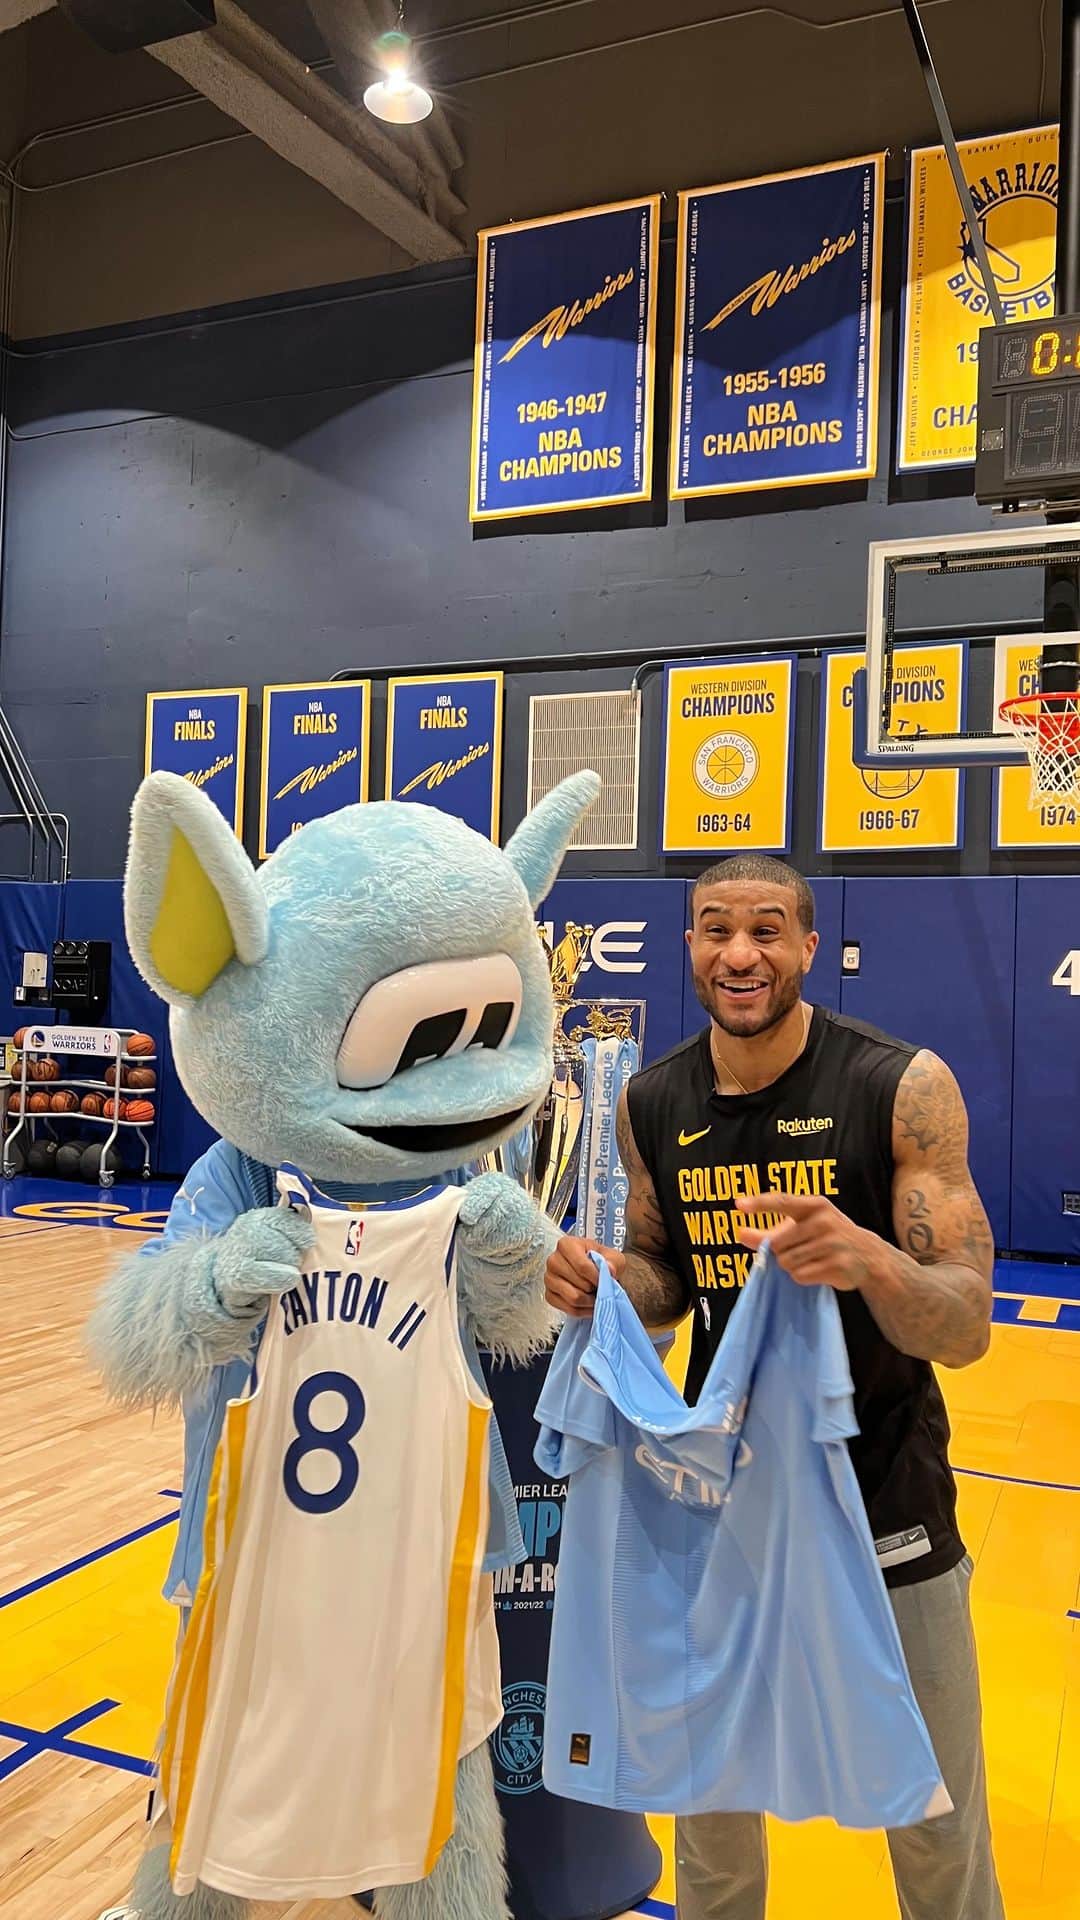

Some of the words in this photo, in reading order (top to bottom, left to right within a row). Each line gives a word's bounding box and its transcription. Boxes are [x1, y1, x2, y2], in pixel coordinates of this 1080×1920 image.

[699, 229, 856, 333] Warriors
[498, 266, 634, 364] Warriors
[723, 362, 826, 396] 1955-1956
[516, 391, 607, 423] 1946-1947
[747, 400, 797, 427] NBA
[537, 427, 583, 453] NBA
[703, 420, 842, 457] CHAMPIONS
[499, 445, 622, 482] CHAMPIONS
[896, 665, 936, 680] DIVISION
[690, 681, 729, 695] WESTERN
[730, 679, 767, 694] DIVISION
[188, 708, 202, 720] NBA
[308, 701, 323, 713] NBA
[436, 695, 452, 707] NBA
[681, 691, 775, 719] CHAMPIONS
[174, 719, 216, 741] FINALS
[293, 712, 337, 735] FINALS
[420, 706, 468, 730] FINALS
[698, 747, 711, 766] SAN
[711, 736, 754, 764] FRANCISCO
[878, 743, 915, 753] SPALDING
[273, 746, 358, 800] Warriors
[396, 741, 490, 797] Warriors
[701, 776, 749, 795] WARRIORS
[697, 813, 751, 833] 1963-64
[859, 808, 920, 830] 1966-67
[52, 1040, 97, 1051] WARRIORS
[598, 1051, 616, 1108] League
[777, 1116, 833, 1134] Rakuten
[594, 1112, 611, 1168] Premier
[678, 1163, 761, 1203] GOLDEN
[767, 1158, 840, 1197] STATE
[387, 1301, 427, 1351] II
[282, 1371, 366, 1514] 8
[513, 1600, 544, 1610] 2021/22
[506, 1774, 533, 1785] CITY
